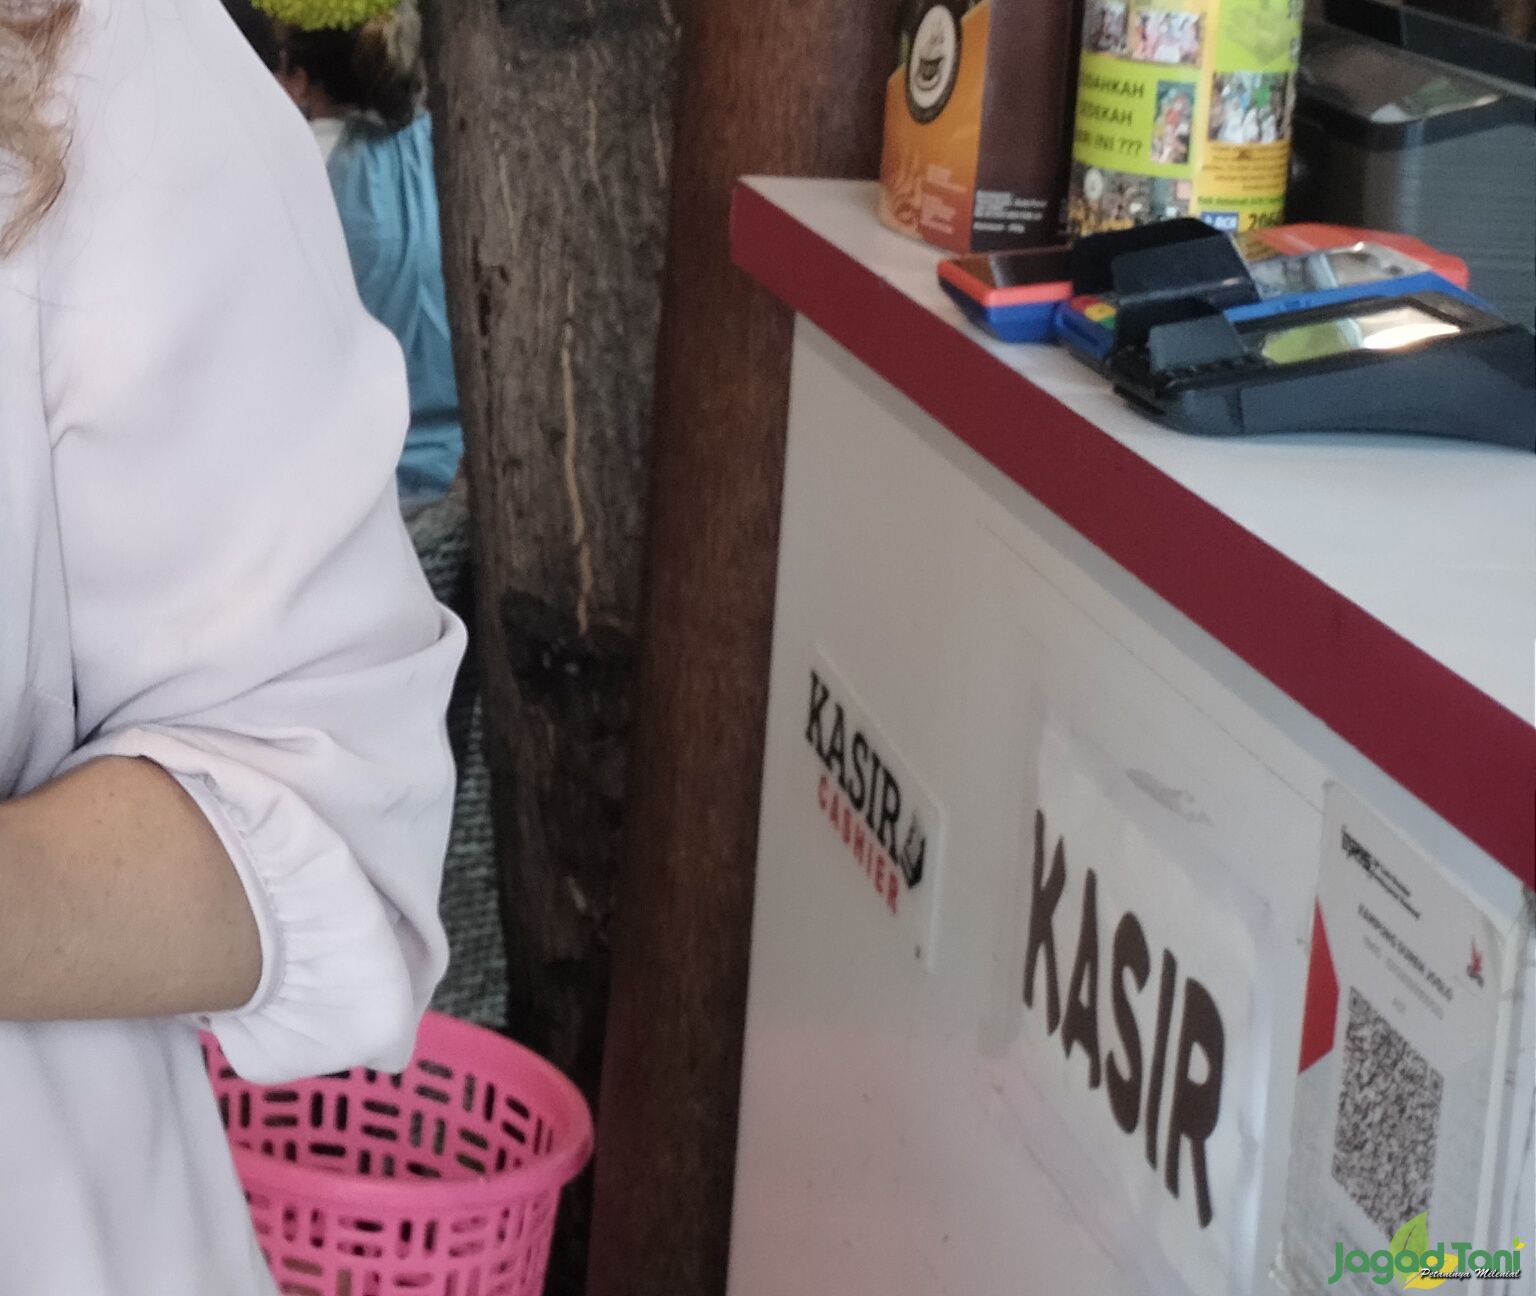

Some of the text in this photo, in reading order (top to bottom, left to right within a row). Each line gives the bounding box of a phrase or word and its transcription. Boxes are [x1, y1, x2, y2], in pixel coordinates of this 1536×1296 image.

[805, 669, 901, 866] KASIR
[818, 773, 899, 915] CASHIER
[1022, 808, 1225, 1230] KASIR
